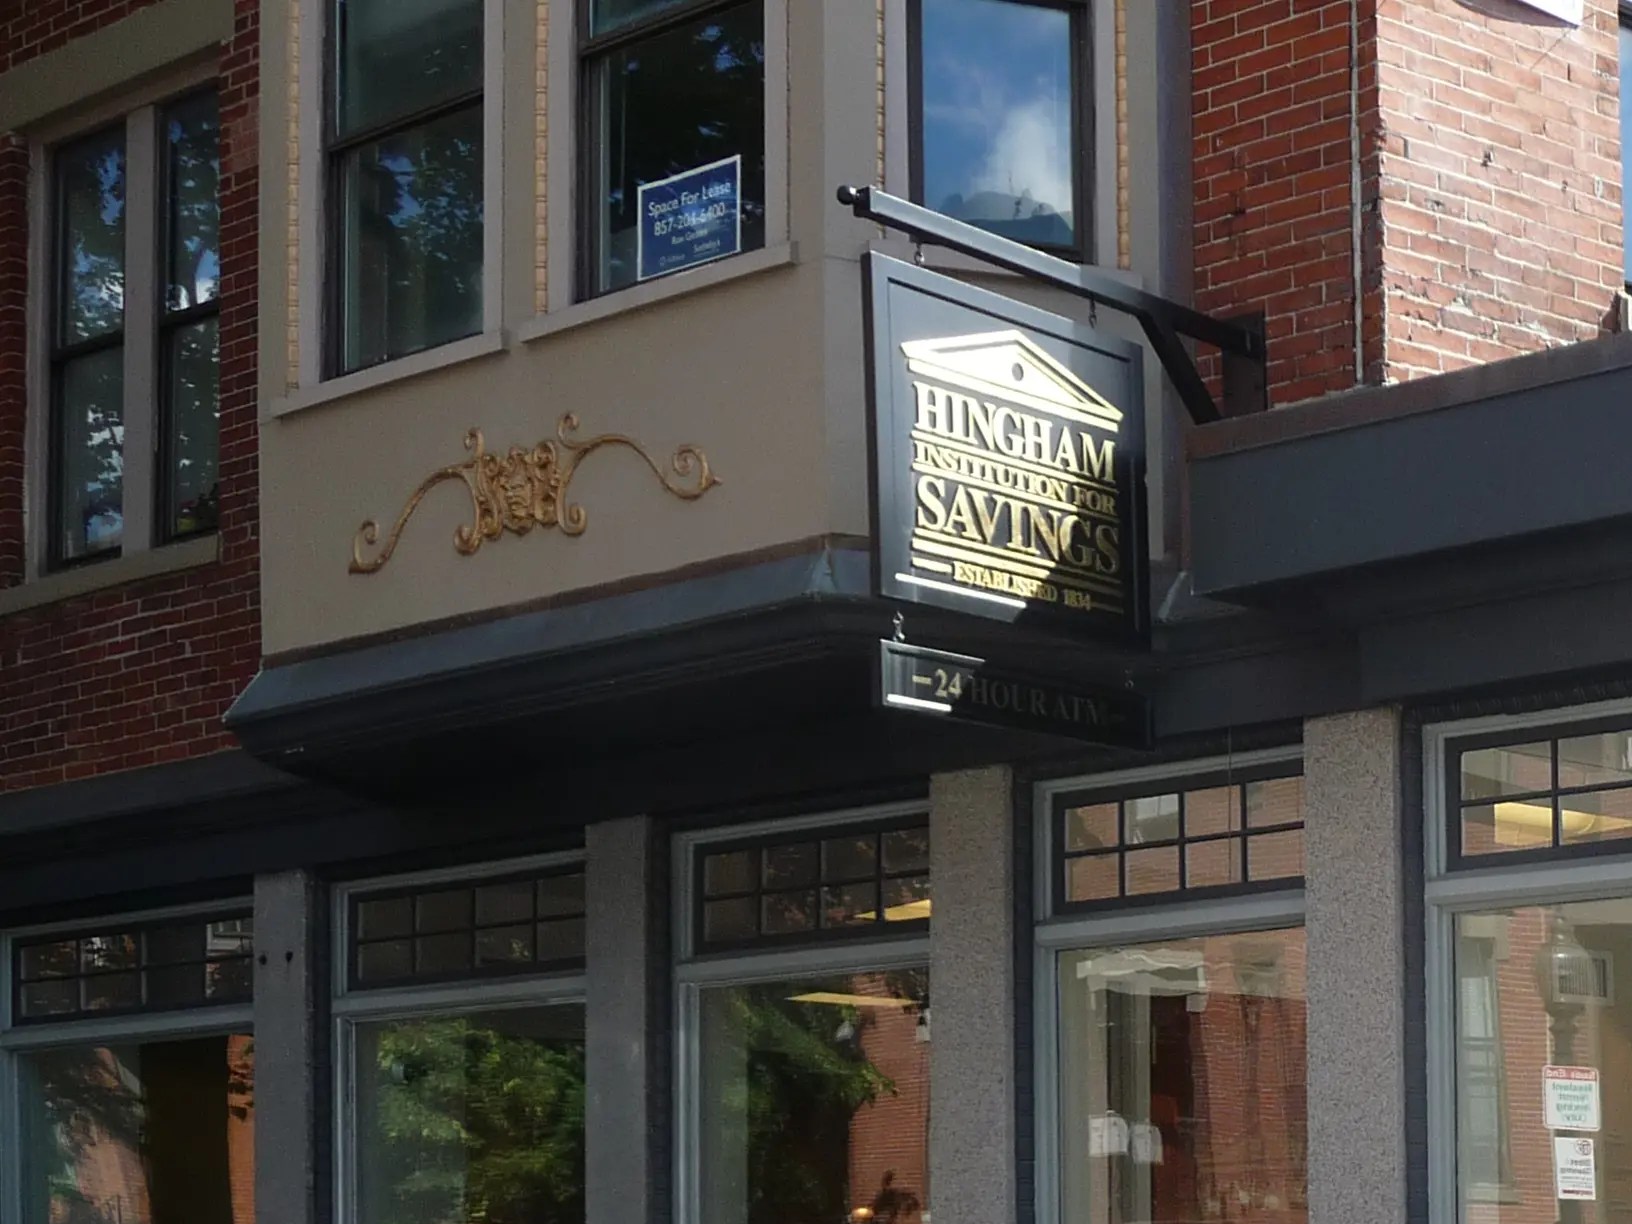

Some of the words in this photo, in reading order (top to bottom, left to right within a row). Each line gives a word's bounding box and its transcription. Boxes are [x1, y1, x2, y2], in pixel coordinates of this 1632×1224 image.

[648, 198, 679, 219] Space
[681, 190, 700, 206] For
[702, 181, 731, 201] Lease
[913, 381, 1116, 483] HINGHAM
[914, 439, 1069, 503] INSTITUTION
[1073, 484, 1118, 517] FOR
[916, 477, 1121, 575] SAVINGS
[953, 559, 1059, 603] ESTABLISHED
[1062, 586, 1093, 611] 1834
[934, 668, 962, 699] 24
[970, 677, 1048, 717] HOUR
